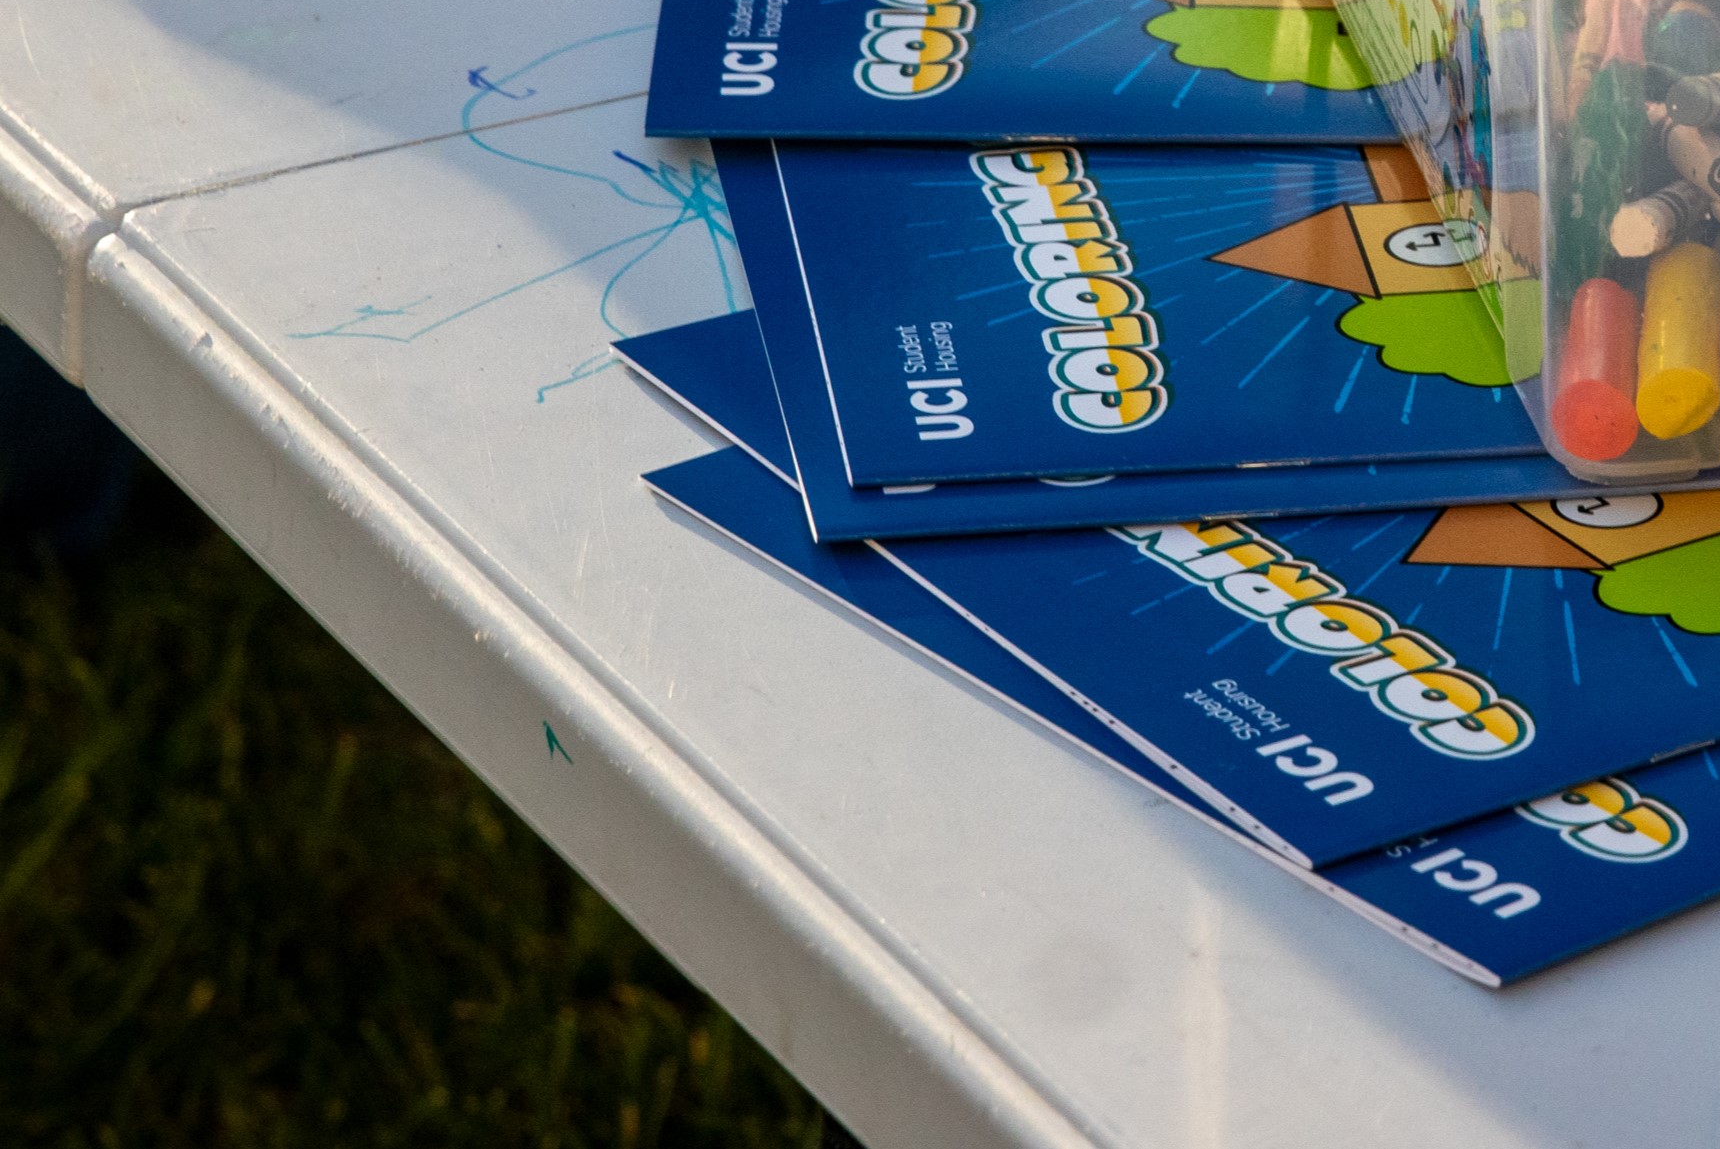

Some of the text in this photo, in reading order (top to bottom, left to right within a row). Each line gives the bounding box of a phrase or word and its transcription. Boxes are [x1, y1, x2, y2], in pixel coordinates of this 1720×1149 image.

[720, 42, 779, 96] UCI
[970, 147, 1168, 434] COLORING
[895, 323, 927, 374] Student
[929, 320, 959, 372] Housing
[906, 377, 975, 441] UCI
[1104, 520, 1536, 760] COLORIN
[1184, 688, 1261, 741] Student
[1211, 678, 1291, 733] Housing
[1256, 734, 1375, 807] UCI
[1410, 847, 1542, 919] UCI
